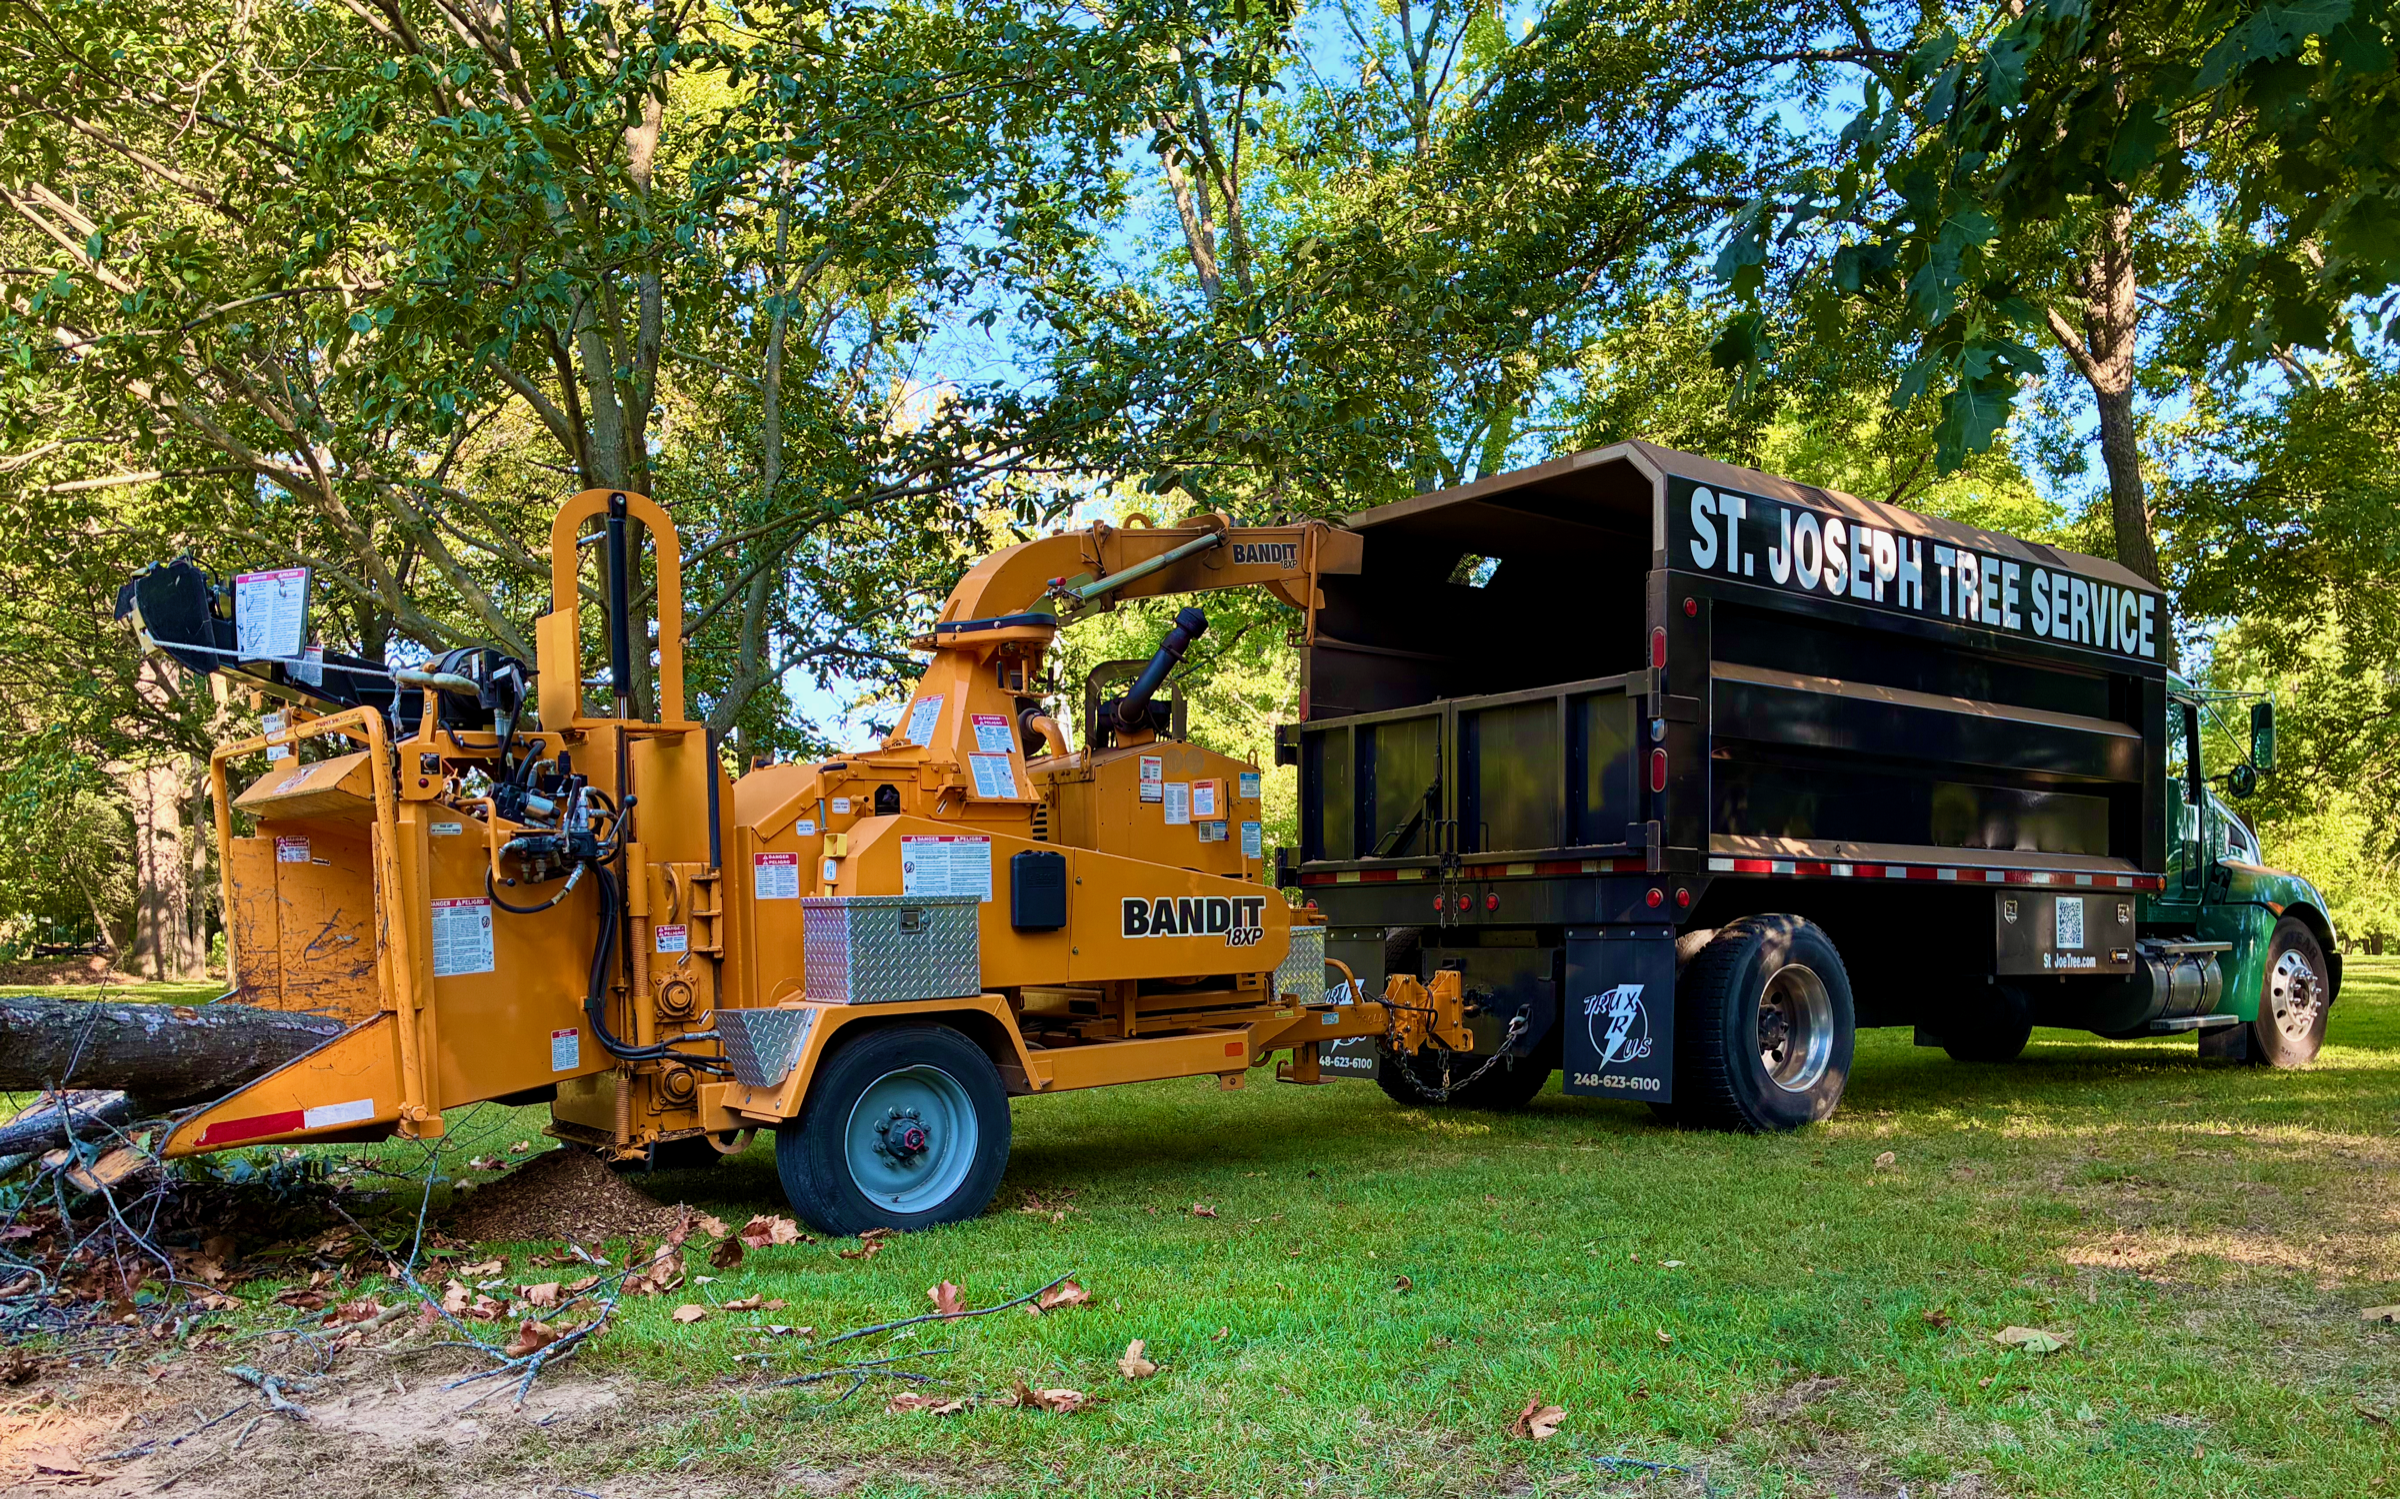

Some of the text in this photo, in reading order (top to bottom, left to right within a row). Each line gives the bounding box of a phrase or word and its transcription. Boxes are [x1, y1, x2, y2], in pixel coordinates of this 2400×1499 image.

[1232, 543, 1297, 563] BANDIT
[1280, 559, 1298, 569] 18XP
[1690, 486, 2155, 659] ST. JOSEPH TREE SERVICE
[1123, 897, 1266, 937] BANDIT
[1224, 927, 1265, 946] 18XP
[2043, 952, 2052, 969] St
[2054, 952, 2097, 969] JoeTree.com
[1583, 991, 1637, 1015] TRUX
[1611, 1015, 1629, 1034] R
[1623, 1037, 1653, 1059] US
[1319, 1055, 1373, 1070] 48-623-6100
[1573, 1072, 1661, 1092] 248-623-6100
